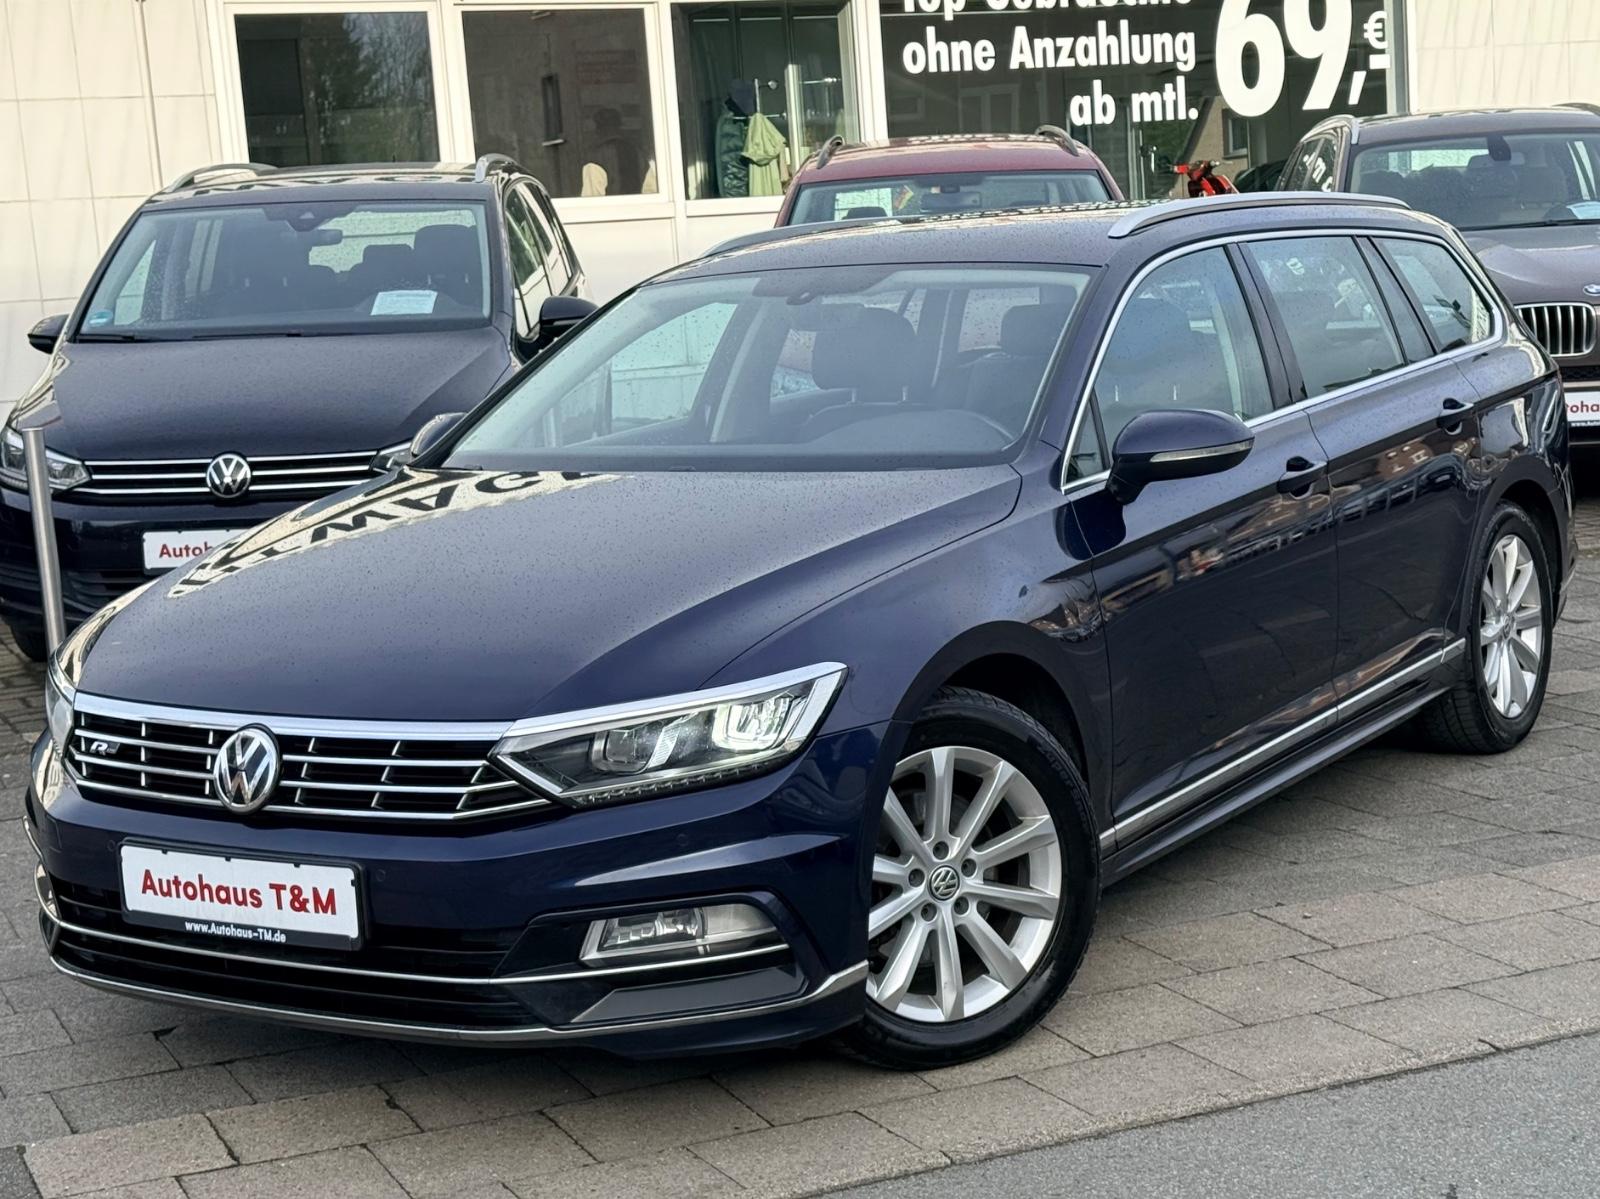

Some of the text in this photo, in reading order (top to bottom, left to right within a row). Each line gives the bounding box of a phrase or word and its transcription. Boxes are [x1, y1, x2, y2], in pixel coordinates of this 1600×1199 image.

[902, 19, 1196, 74] ohne Anzahlung
[1070, 75, 1199, 126] ab mtl.
[213, 727, 280, 813] VW
[141, 869, 337, 916] Autohaus T&M
[184, 920, 286, 943] www.Autohaus-TM.de
